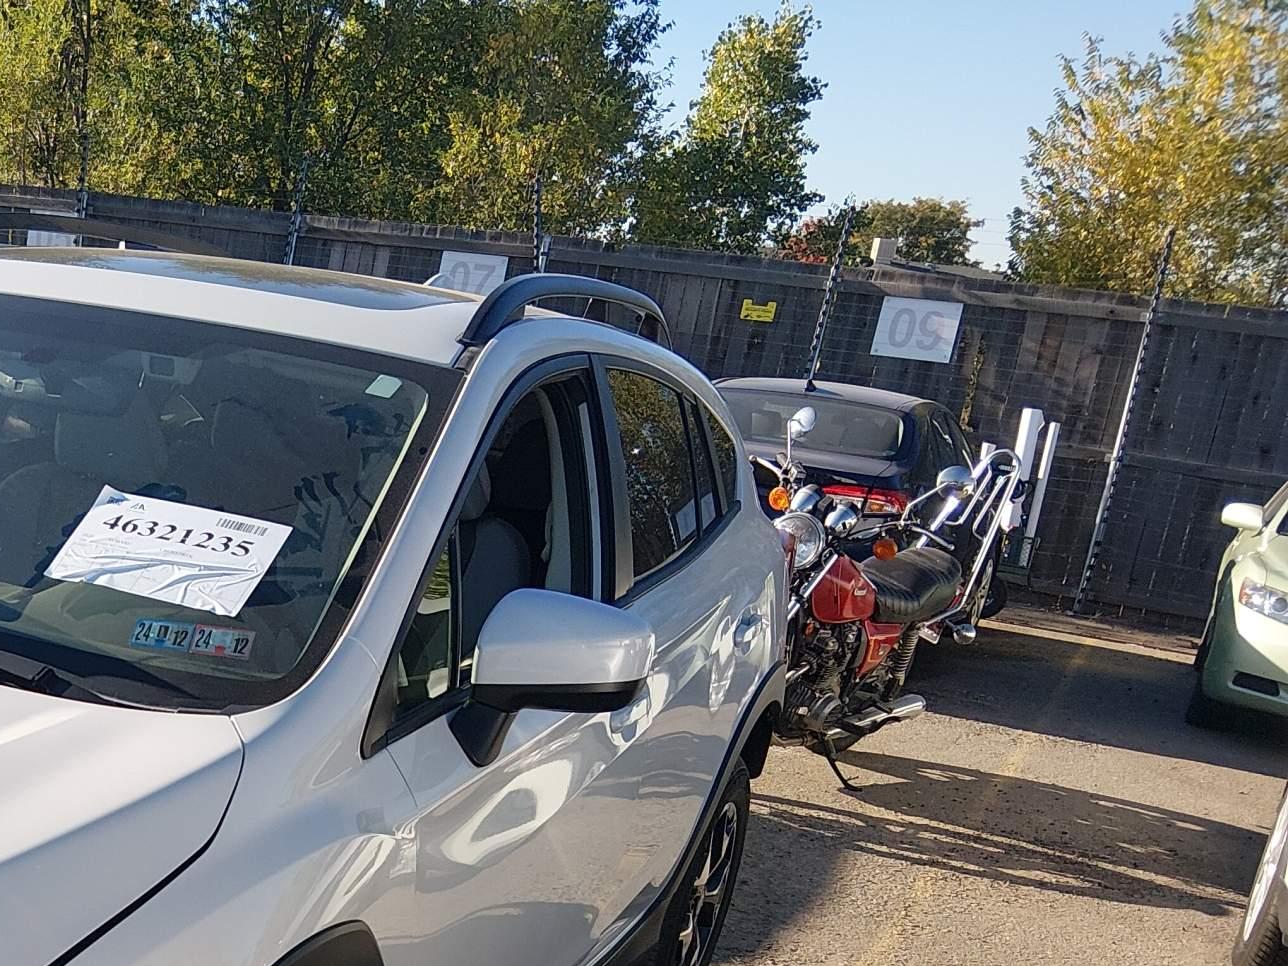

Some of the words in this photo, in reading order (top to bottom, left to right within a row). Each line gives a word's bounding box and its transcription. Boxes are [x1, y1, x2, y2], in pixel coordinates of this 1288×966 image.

[450, 261, 496, 293] 07
[102, 514, 255, 557] 46321235
[135, 622, 152, 641] 24
[172, 630, 189, 647] 12
[195, 628, 213, 648] 24
[232, 637, 250, 655] 12
